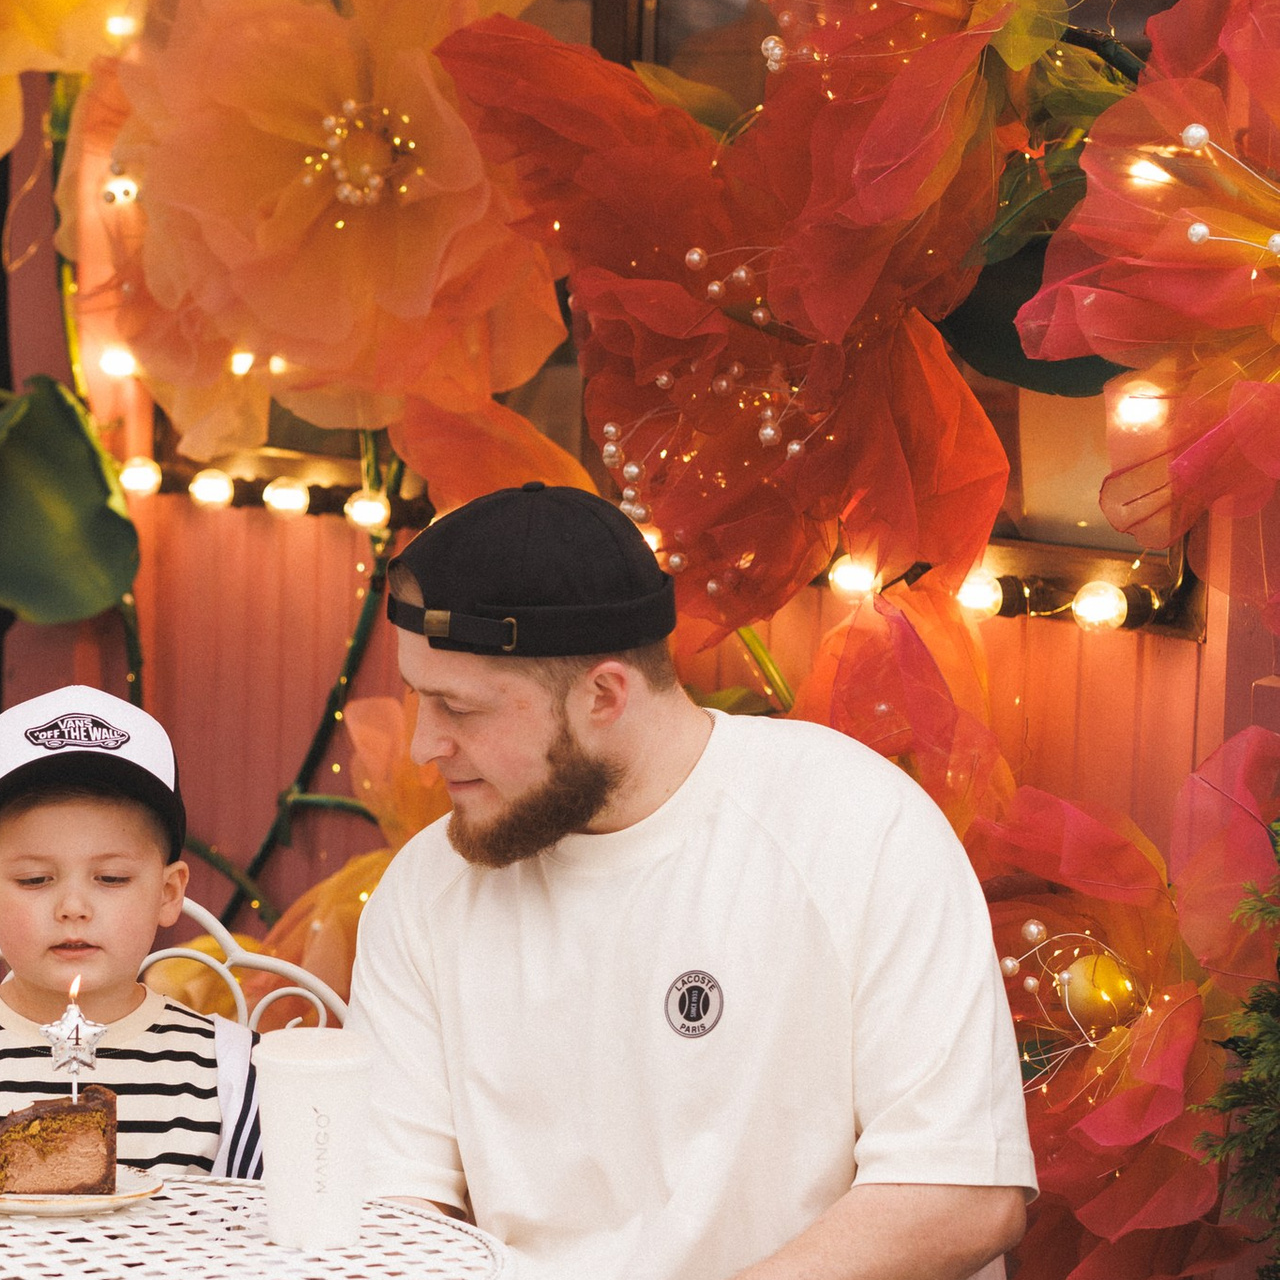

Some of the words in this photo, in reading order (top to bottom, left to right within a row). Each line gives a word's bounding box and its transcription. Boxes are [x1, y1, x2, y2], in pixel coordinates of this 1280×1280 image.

[57, 719, 93, 730] VANS
[61, 727, 89, 741] THE
[675, 974, 716, 992] LACOSTE
[66, 1023, 82, 1046] 4
[680, 1023, 706, 1033] PARIS
